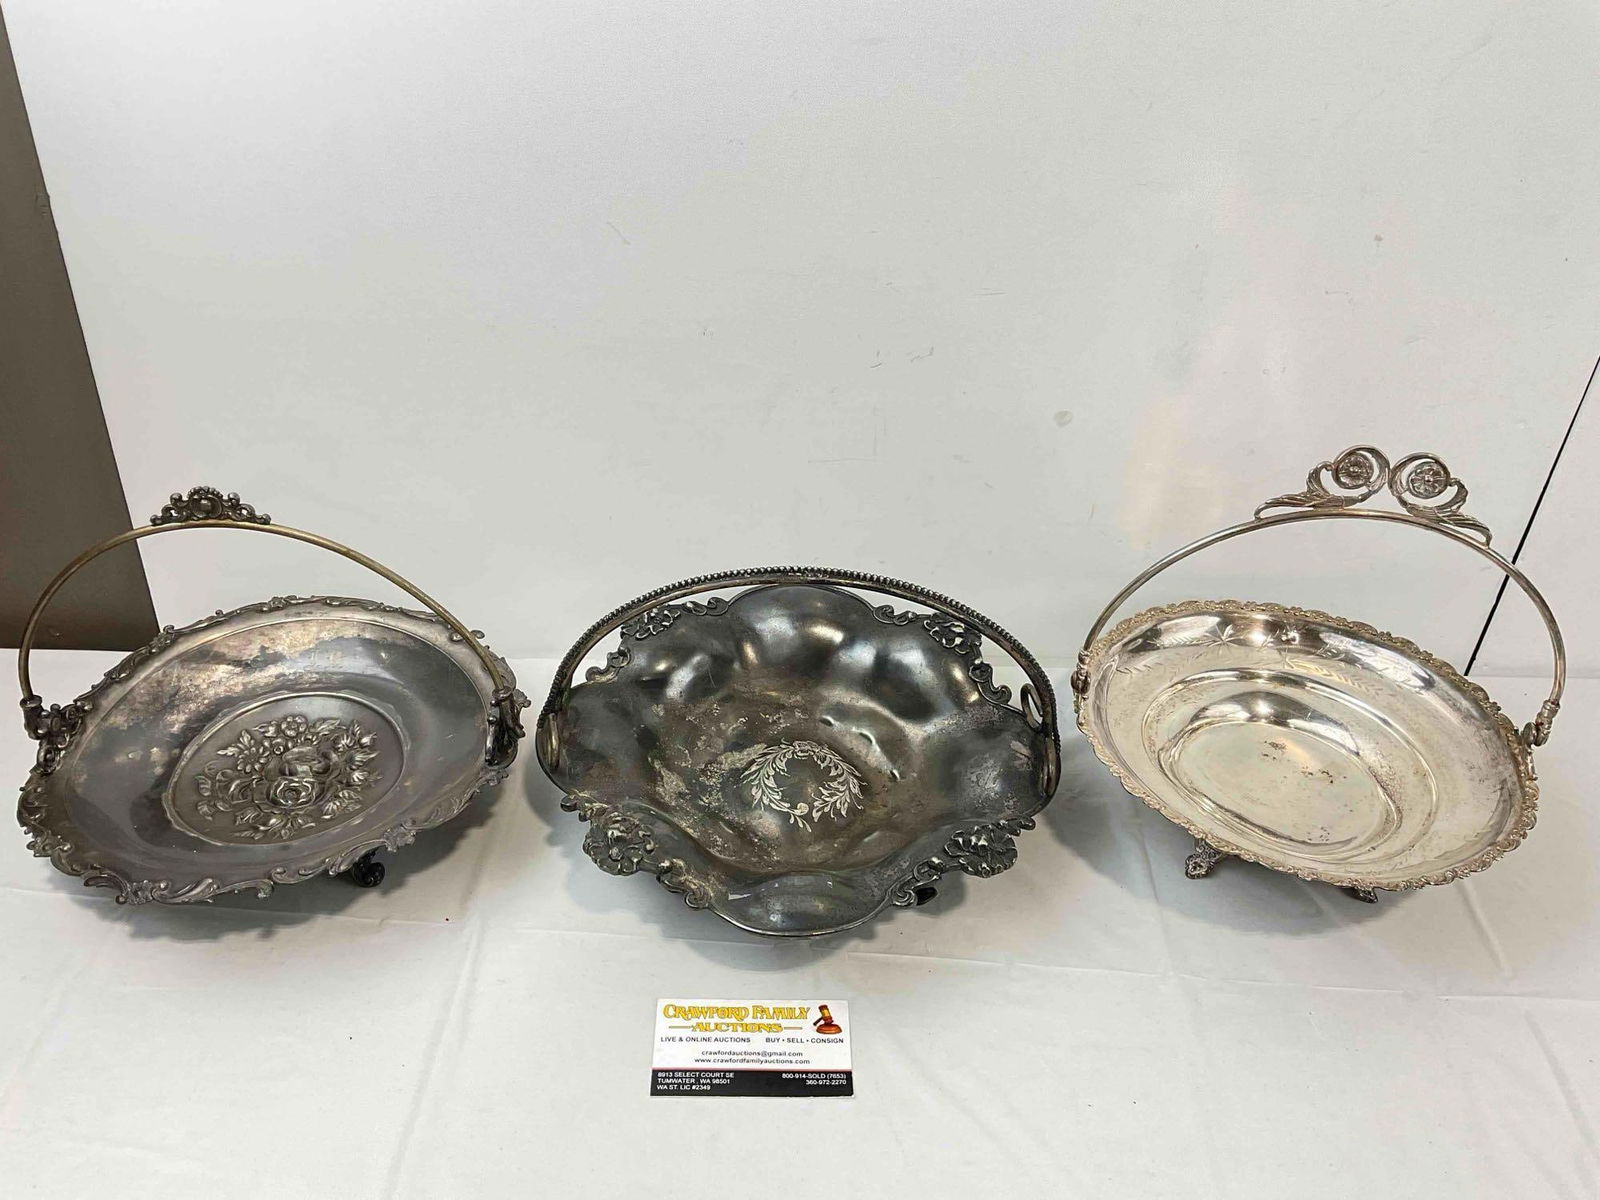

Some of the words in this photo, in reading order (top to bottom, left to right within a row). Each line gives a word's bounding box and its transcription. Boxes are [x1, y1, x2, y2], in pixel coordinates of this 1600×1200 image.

[663, 1004, 749, 1022] CRAWFORD
[752, 1005, 810, 1019] FAMILY
[691, 1022, 783, 1033] AUCTIONS
